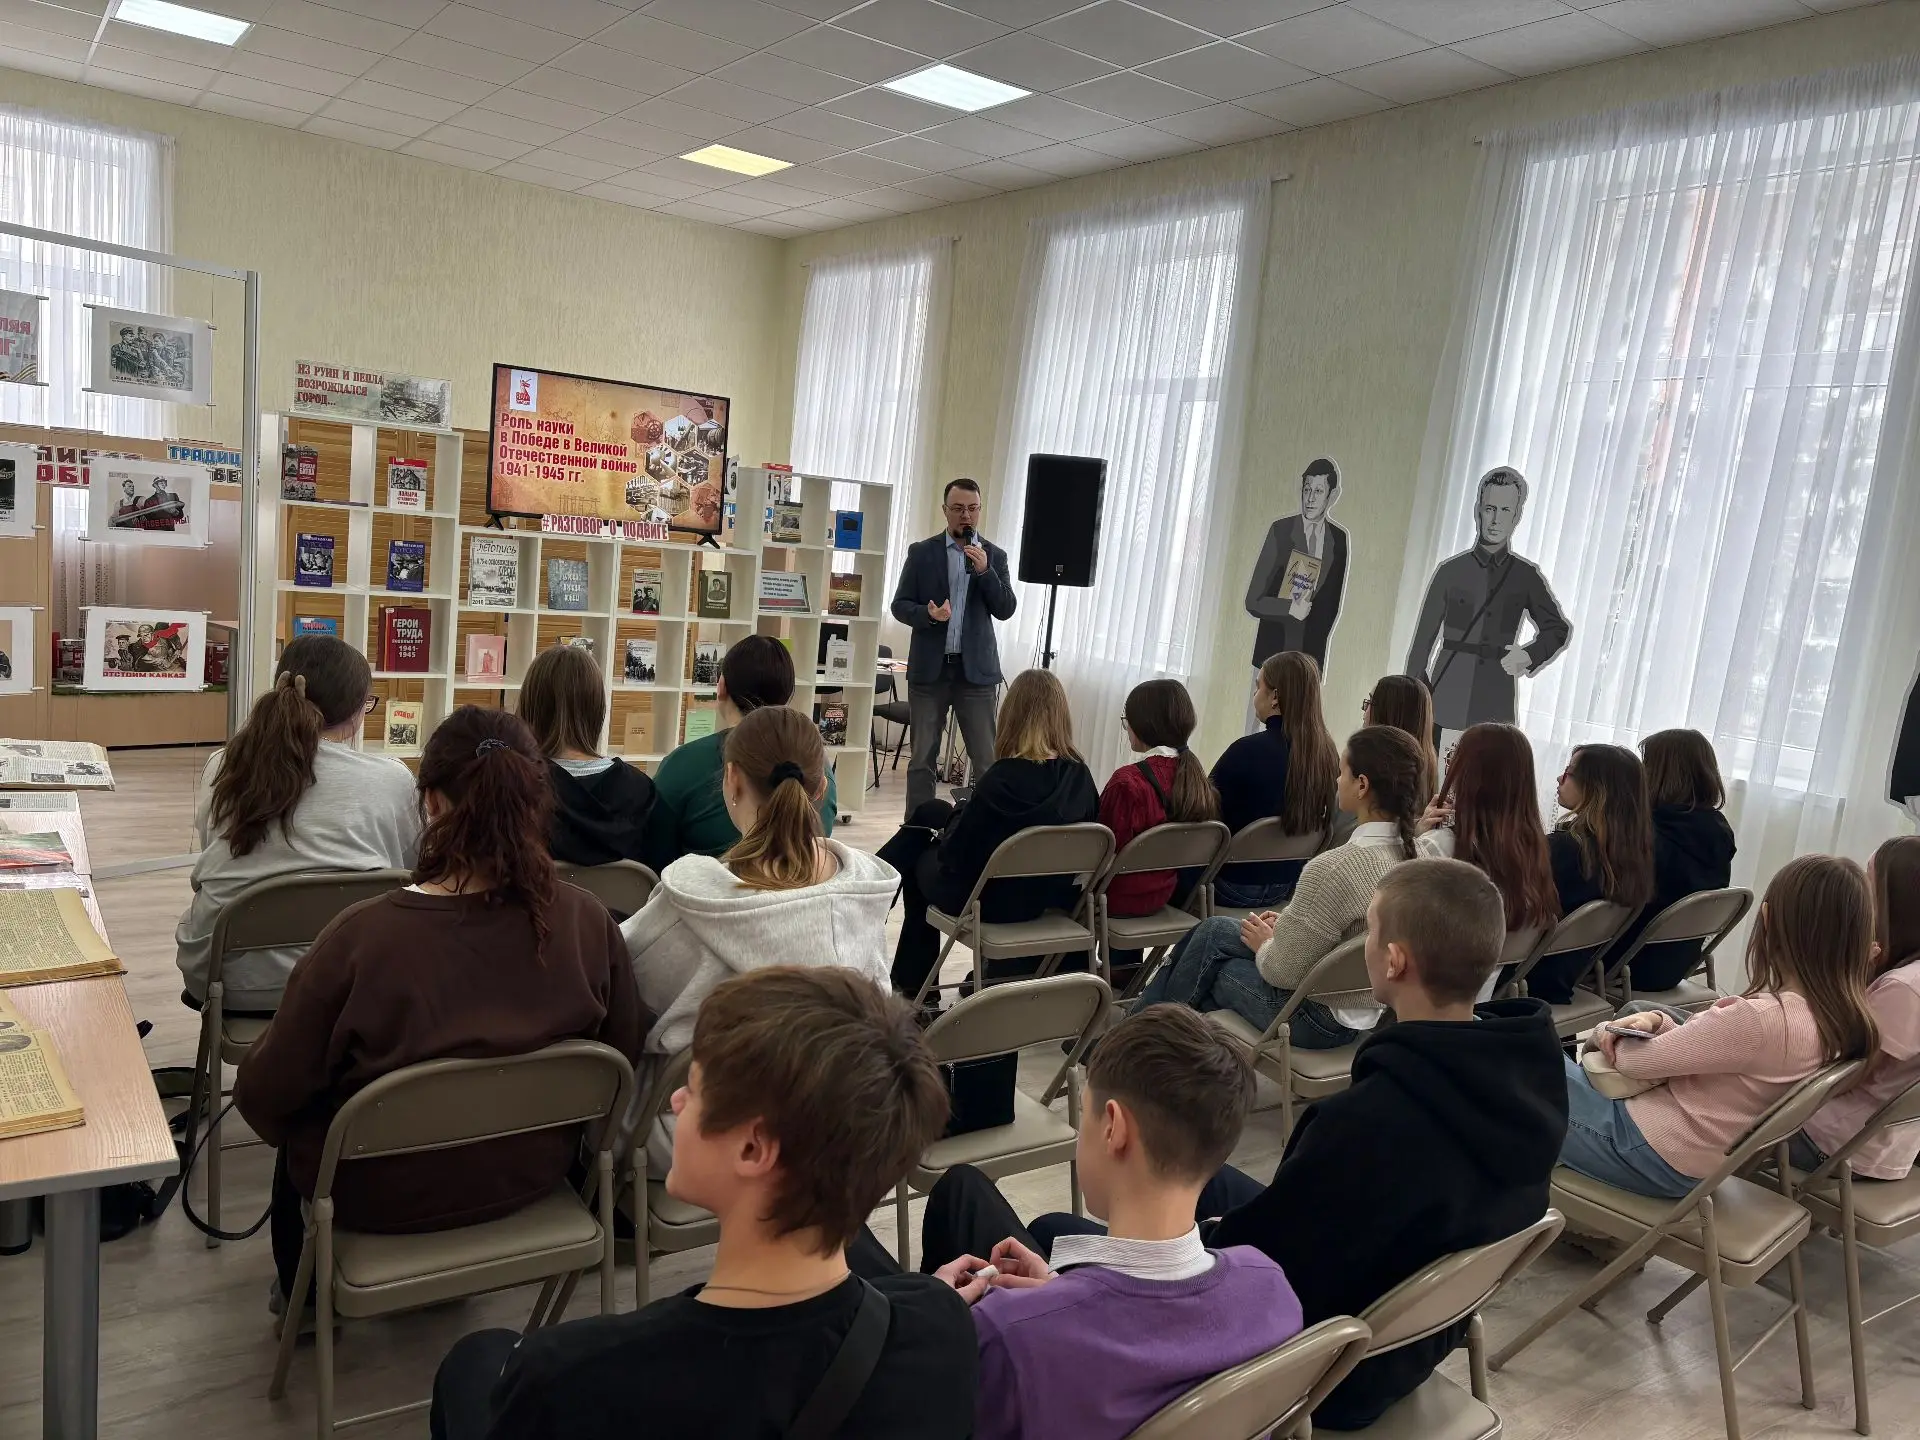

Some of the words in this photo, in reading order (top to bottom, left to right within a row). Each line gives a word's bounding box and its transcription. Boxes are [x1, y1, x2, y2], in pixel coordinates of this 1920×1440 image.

[297, 363, 311, 376] ИЗ
[314, 366, 340, 379] РУИН
[343, 370, 350, 381] И
[353, 372, 384, 386] ПЕПЛА
[297, 378, 368, 397] ВОЗРОЖДАЛСЯ
[501, 412, 533, 430] Роль
[536, 420, 574, 436] науки
[500, 431, 508, 442] в
[511, 430, 560, 450] Победе
[563, 440, 571, 450] в
[574, 438, 628, 457] Великой
[499, 445, 598, 470] Отечественной
[600, 460, 638, 474] войне
[499, 462, 565, 482] 1941-1945
[568, 472, 585, 483] гг.
[476, 543, 517, 555] ЛЕТОПИСЬ
[392, 618, 419, 629] ГЕРОИ
[397, 628, 424, 639] ТРУДА
